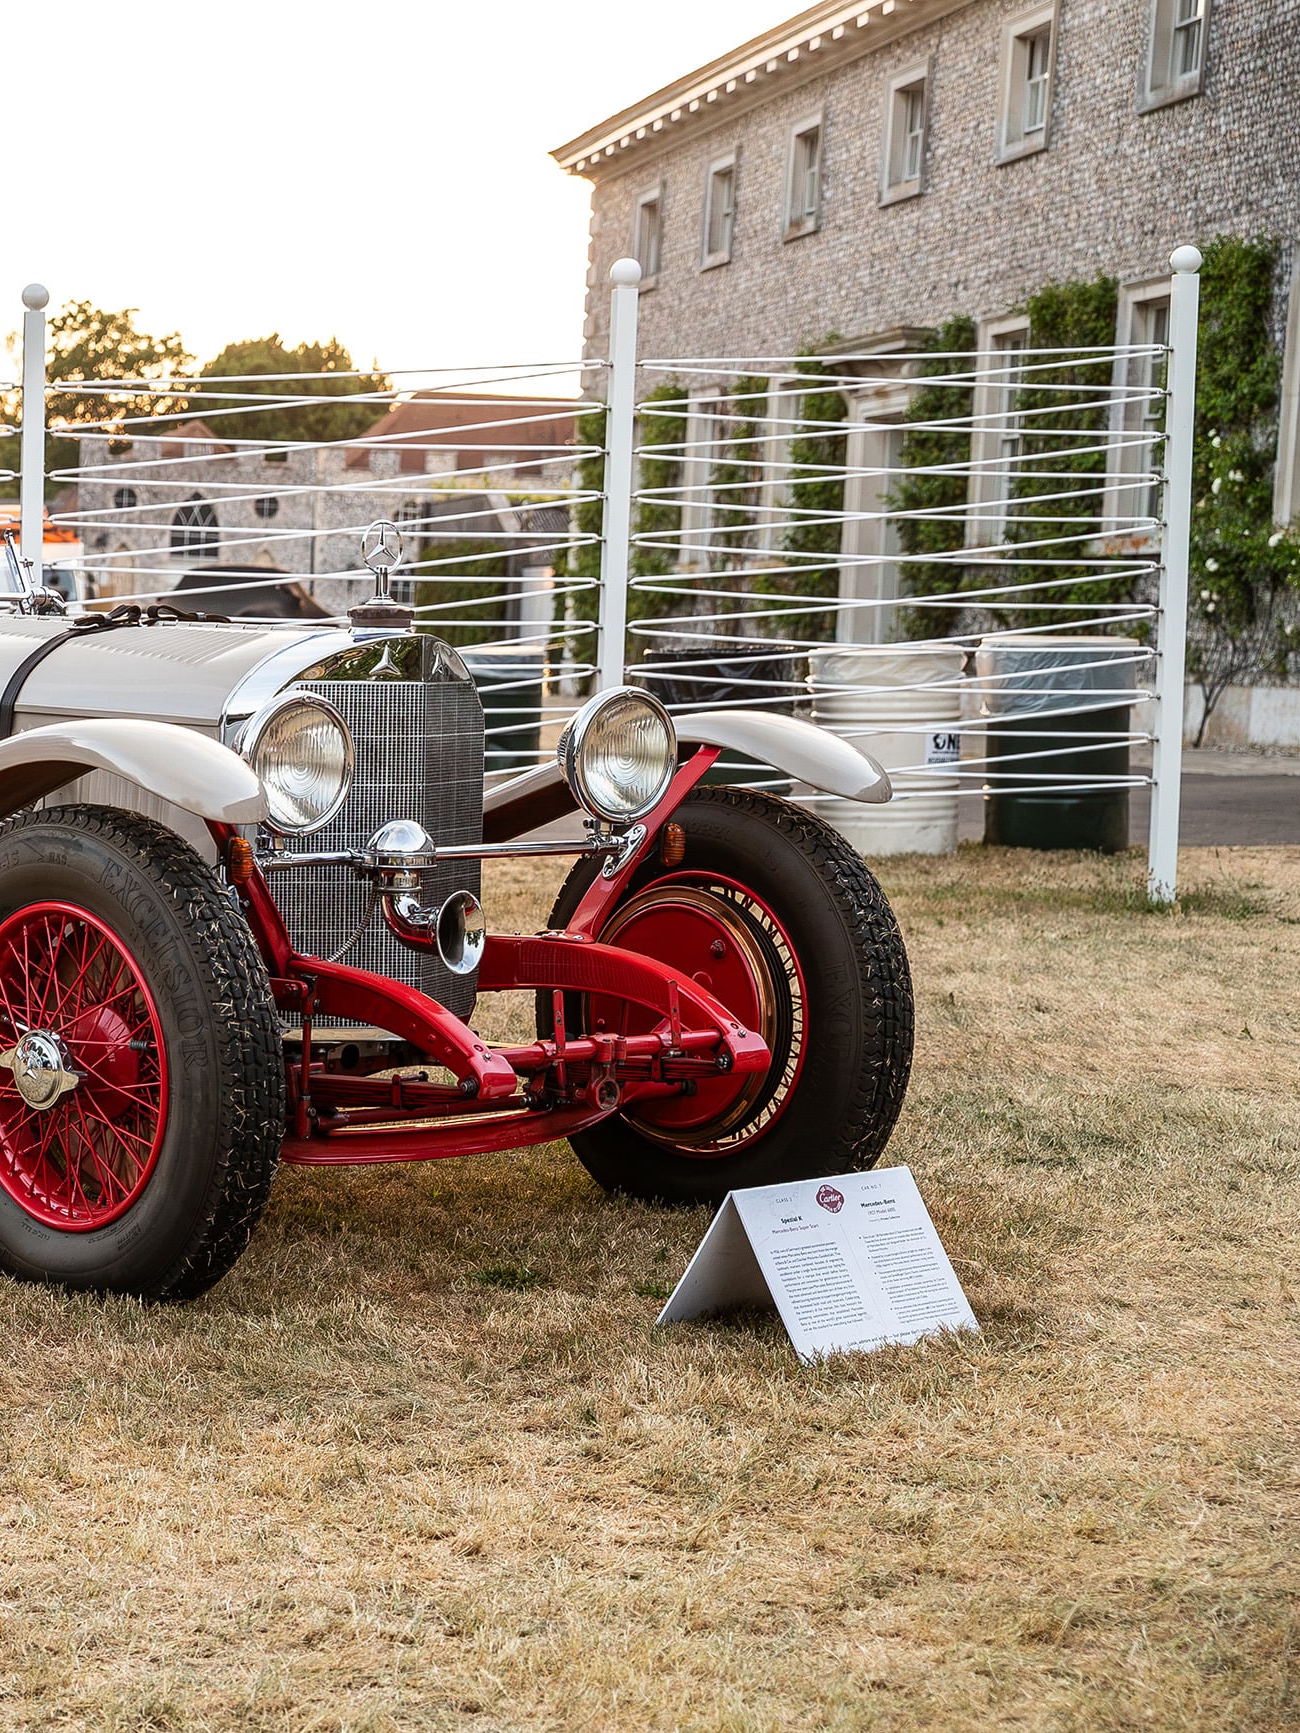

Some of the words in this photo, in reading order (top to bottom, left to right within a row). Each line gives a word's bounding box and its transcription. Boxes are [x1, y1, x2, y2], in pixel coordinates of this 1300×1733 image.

[98, 858, 208, 1070] EXCELSIOR
[819, 1192, 842, 1203] Cartier
[860, 1199, 896, 1208] Mercedes-Benz
[772, 1226, 799, 1234] Mercedes-Benz
